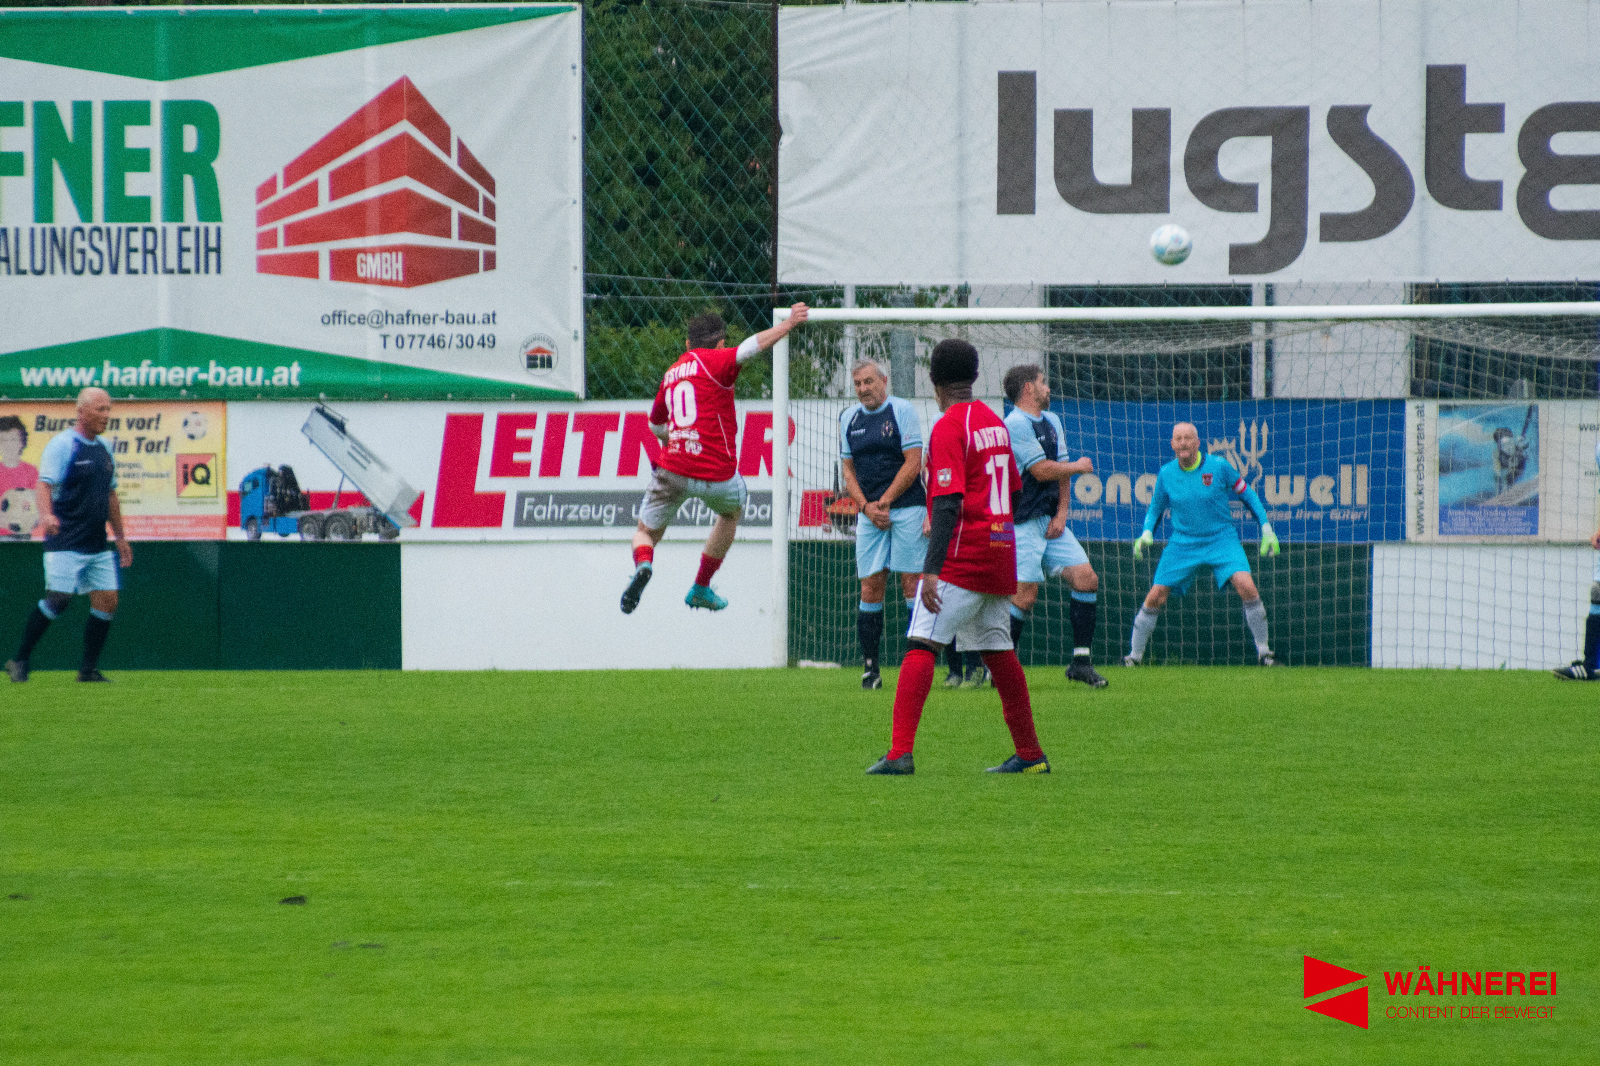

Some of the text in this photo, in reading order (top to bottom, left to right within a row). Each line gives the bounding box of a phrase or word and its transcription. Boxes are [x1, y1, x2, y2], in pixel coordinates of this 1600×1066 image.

[356, 252, 404, 281] GMBH
[320, 309, 497, 329] office@hafner-bau.at
[380, 334, 391, 349] T
[20, 360, 301, 387] www.hafner-bau.at
[126, 413, 161, 431] vor!
[135, 436, 170, 454] Tor!
[431, 411, 796, 528] LEITNR
[1416, 402, 1426, 535] www.krebskran.at
[985, 453, 1010, 515] 17
[1264, 464, 1368, 506] well
[522, 495, 624, 525] Fahrzeug-
